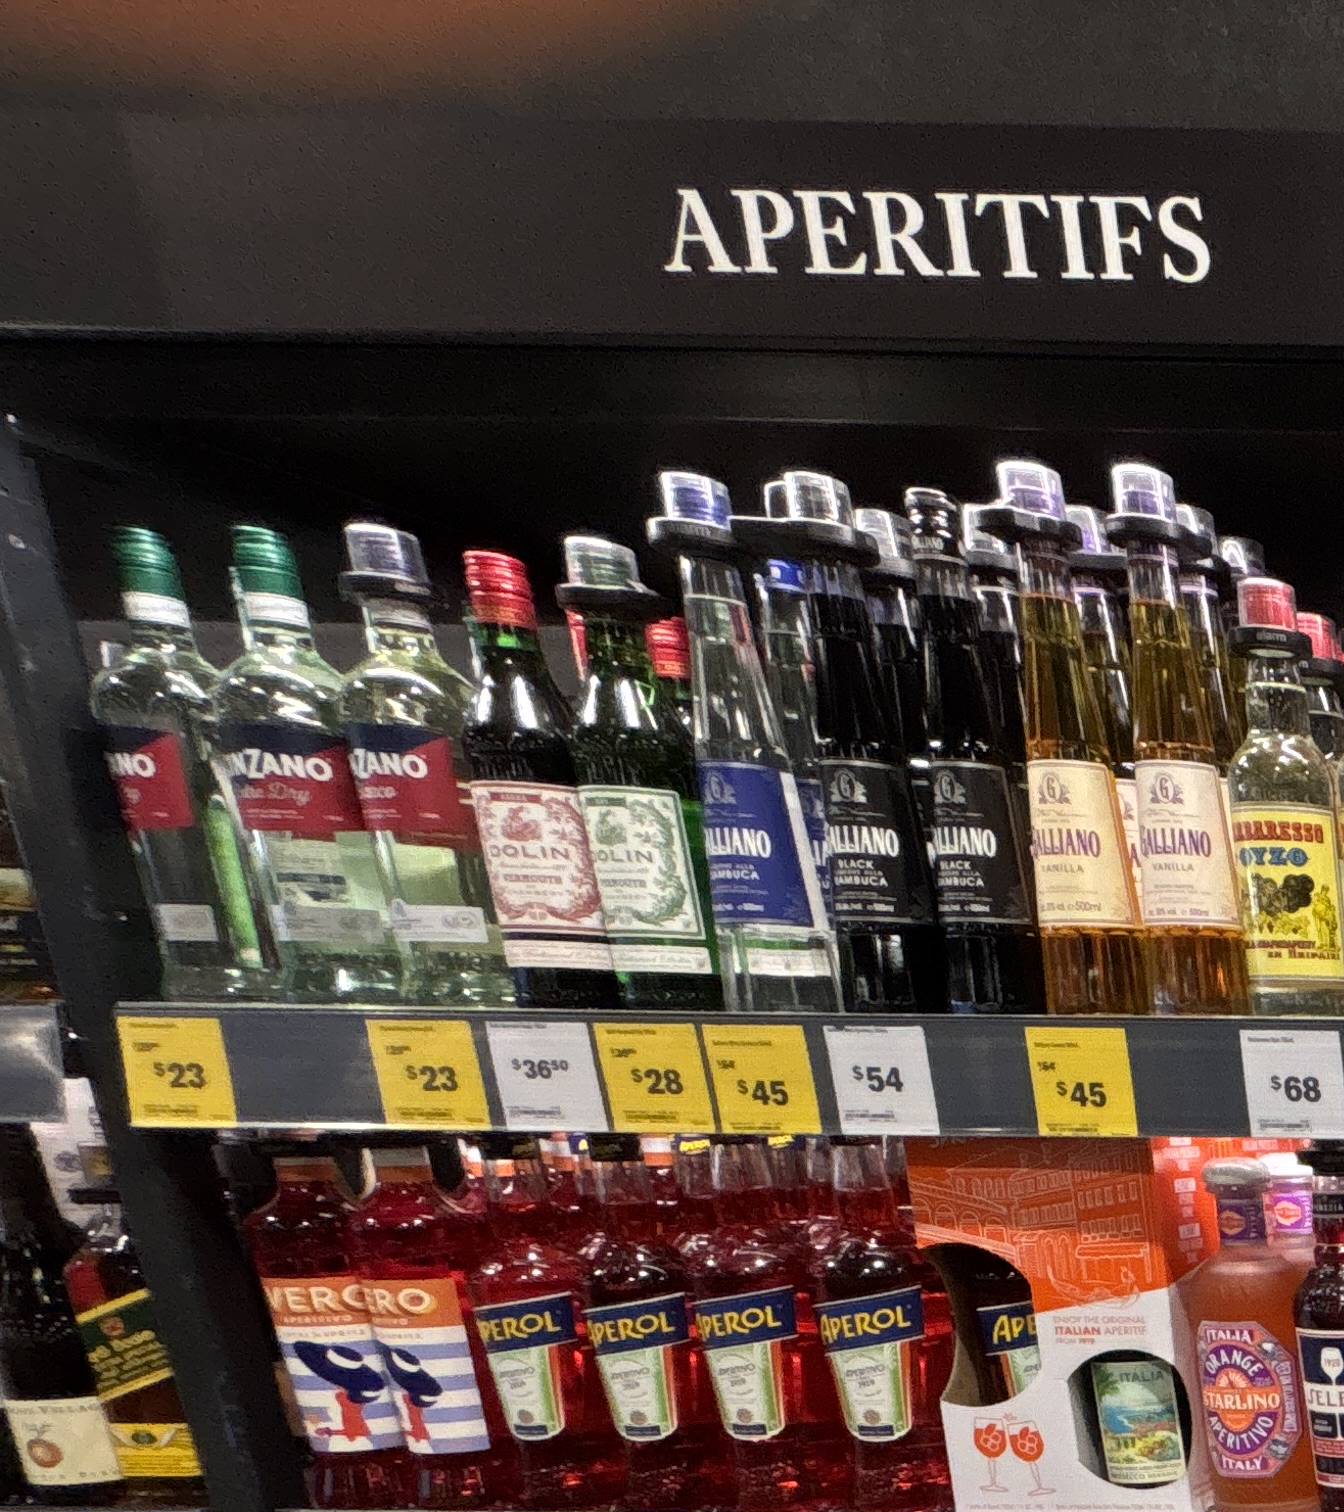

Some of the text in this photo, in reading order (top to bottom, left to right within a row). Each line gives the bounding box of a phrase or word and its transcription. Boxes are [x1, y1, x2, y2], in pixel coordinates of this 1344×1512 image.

[664, 187, 1211, 284] APERITIFS
[154, 1062, 207, 1089] $23
[406, 1066, 458, 1091] $23
[631, 1069, 683, 1094] $28
[853, 1066, 903, 1092] $54
[738, 1080, 788, 1105] $45
[1057, 1081, 1106, 1107] $45
[1271, 1076, 1321, 1102] $68
[819, 1304, 911, 1343] APEROL
[1055, 1326, 1148, 1336] ITALIAN APERITIF
[1205, 1326, 1254, 1343] ITALIA
[1205, 1342, 1265, 1376] ORANGE
[1202, 1391, 1282, 1412] STARLINO
[1207, 1414, 1275, 1452] APERITIVO
[1220, 1457, 1265, 1471] ITALY
